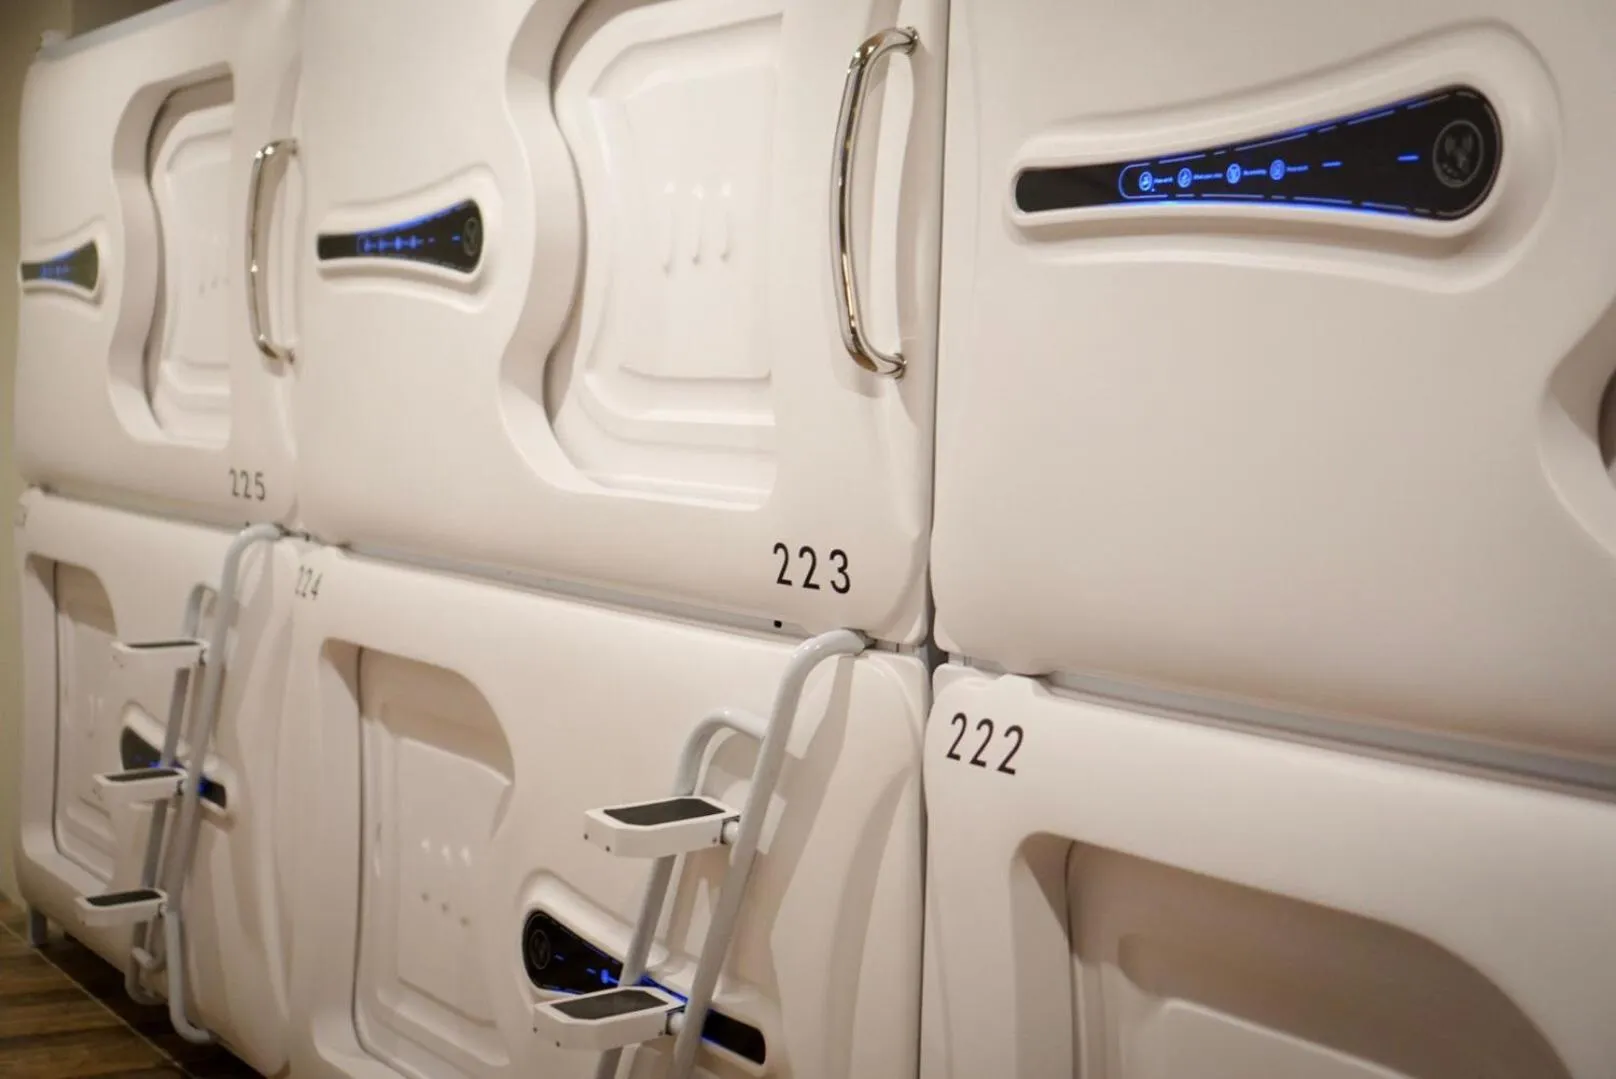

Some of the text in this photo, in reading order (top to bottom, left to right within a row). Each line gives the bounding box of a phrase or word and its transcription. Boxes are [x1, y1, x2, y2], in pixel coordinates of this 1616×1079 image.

[228, 469, 266, 501] 225
[295, 565, 322, 599] 224
[773, 541, 852, 595] 223
[945, 711, 1025, 777] 222
